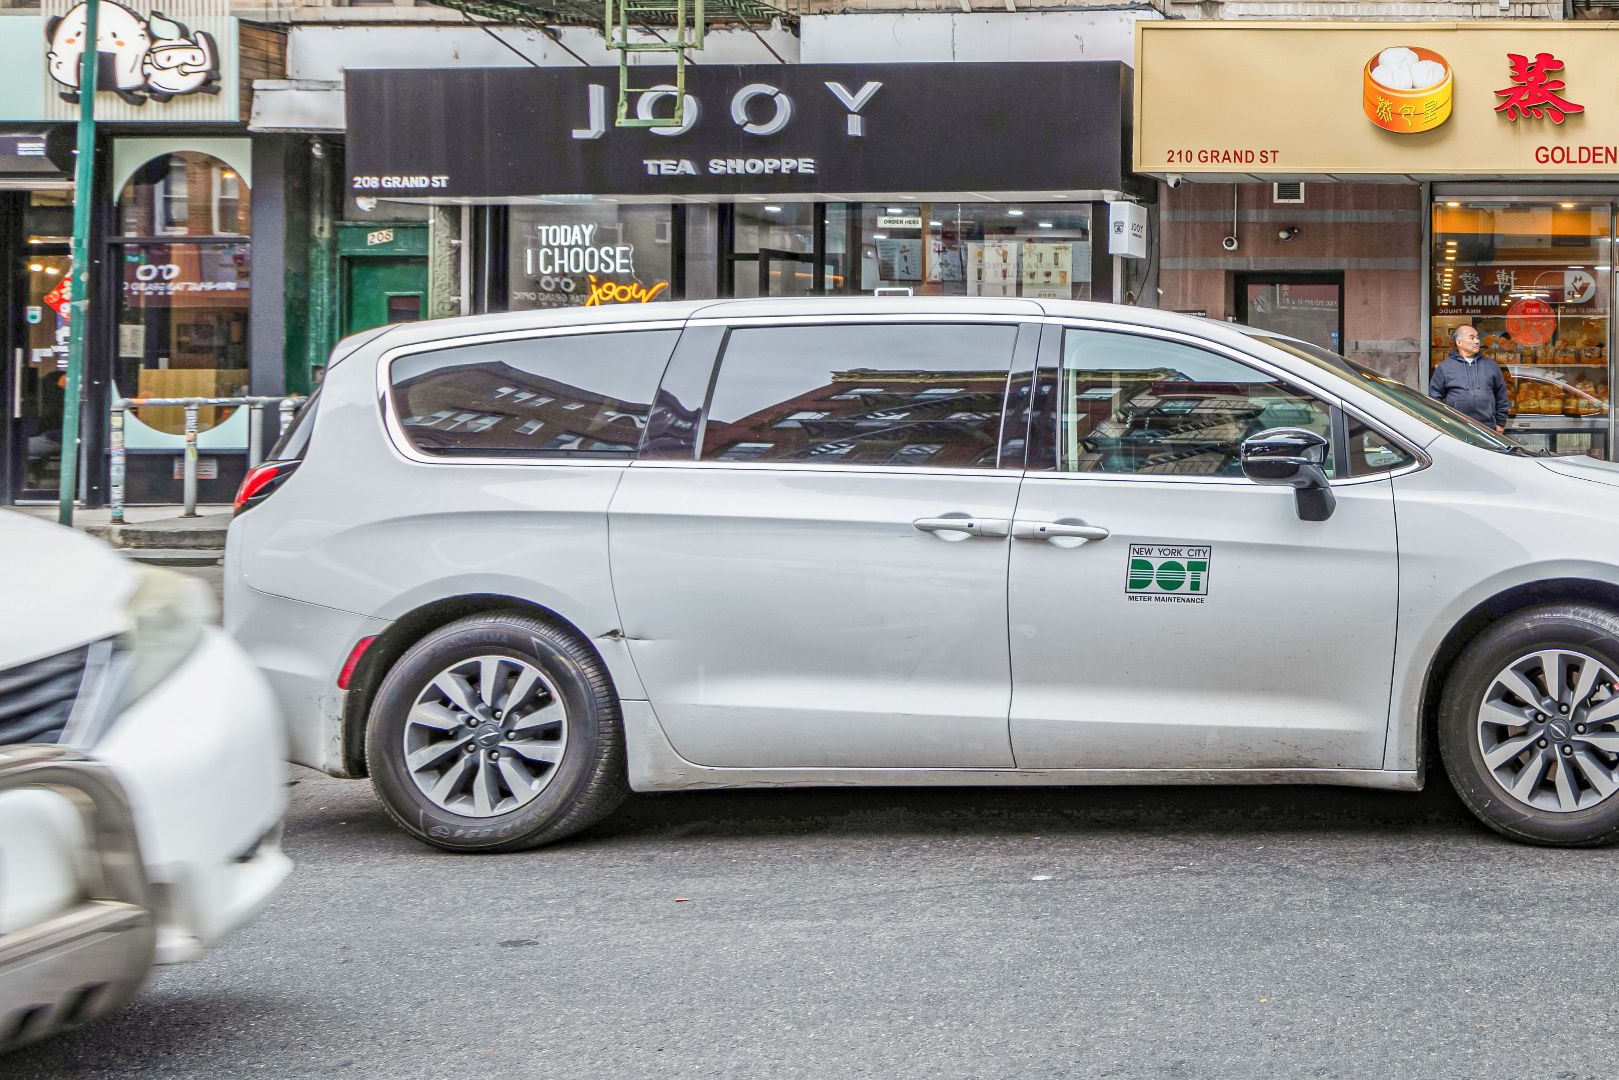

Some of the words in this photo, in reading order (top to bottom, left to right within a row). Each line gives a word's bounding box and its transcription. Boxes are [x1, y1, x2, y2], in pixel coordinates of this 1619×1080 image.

[572, 81, 883, 139] JOOY
[1167, 150, 1193, 164] 210
[1198, 150, 1254, 164] GRAND
[1260, 150, 1280, 164] ST
[1535, 145, 1618, 164] GOLDEN
[643, 159, 696, 175] TEA
[708, 158, 816, 175] SHOPPE
[353, 176, 379, 188] 208
[381, 176, 428, 188] GRAND
[430, 176, 448, 188] ST
[538, 224, 594, 247] TODAY
[526, 248, 532, 275] I
[539, 247, 631, 274] CHOOSE
[1132, 547, 1154, 555] NEW
[1157, 548, 1183, 557] YORK
[1187, 549, 1208, 557] CITY
[1129, 559, 1207, 591] DOT
[1154, 596, 1205, 604] MAINTENANCE
